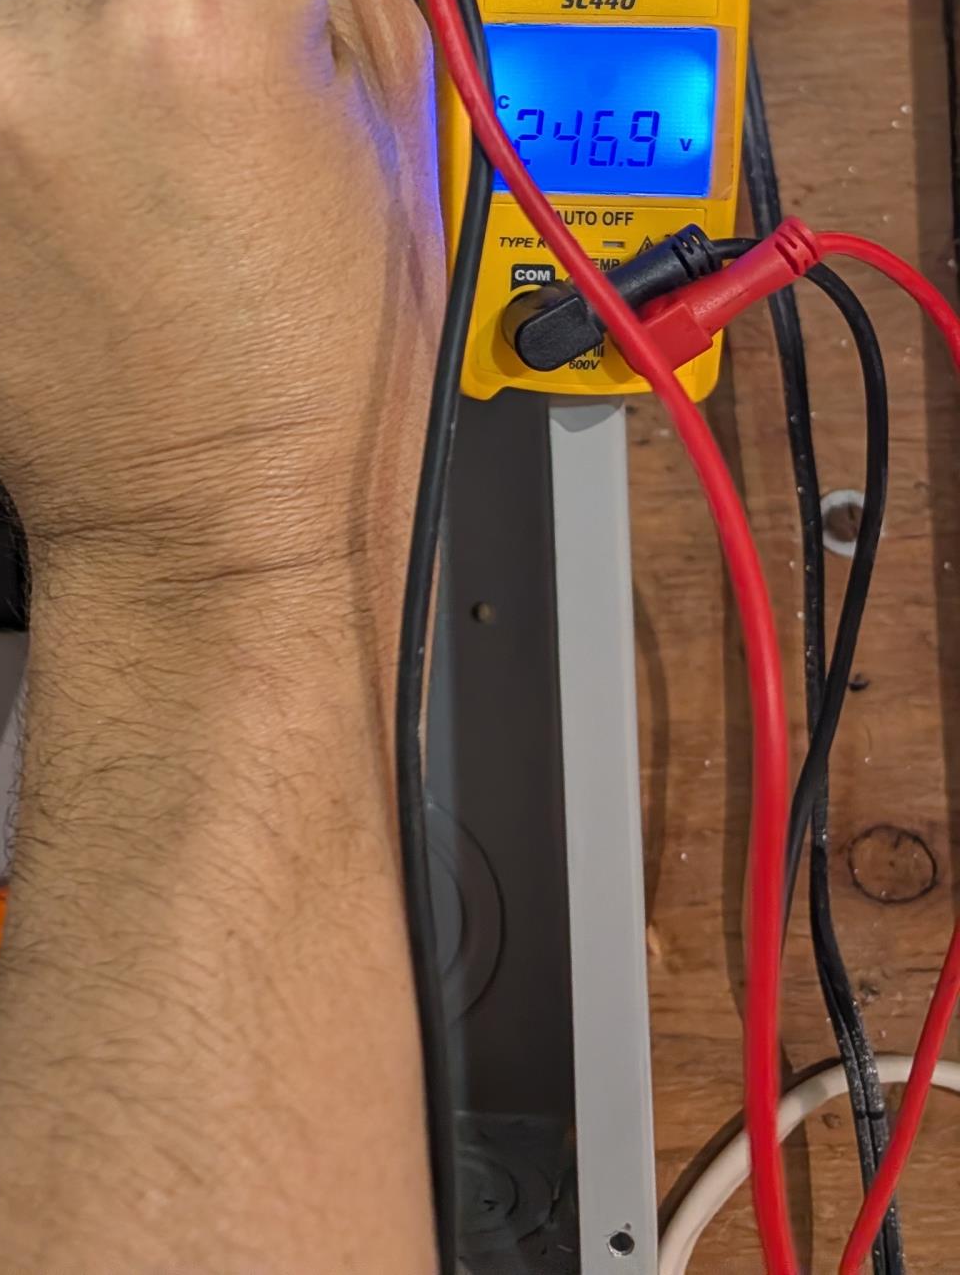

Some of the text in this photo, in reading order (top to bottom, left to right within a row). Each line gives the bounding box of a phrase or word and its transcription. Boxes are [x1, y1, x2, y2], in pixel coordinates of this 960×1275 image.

[514, 109, 660, 167] 246.9
[602, 211, 634, 226] OFF
[499, 236, 534, 248] TYPE
[515, 269, 551, 281] COM
[569, 359, 601, 370] 600V
